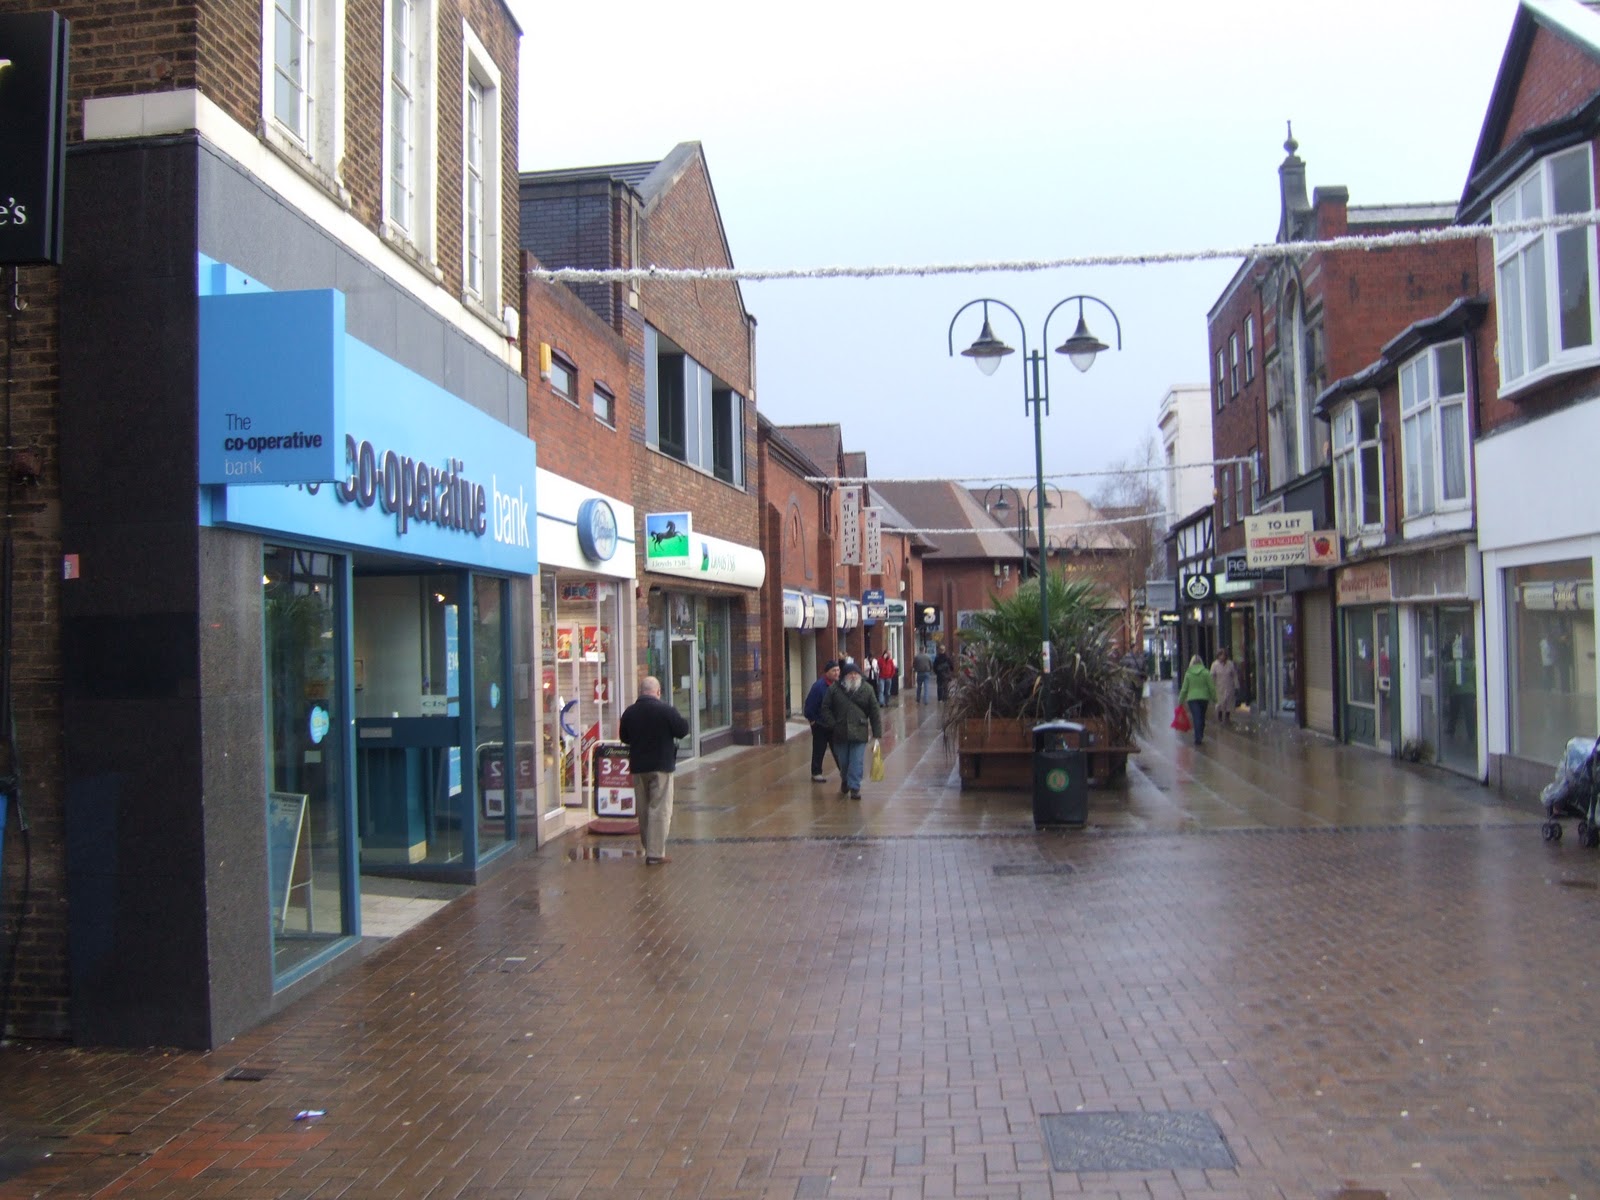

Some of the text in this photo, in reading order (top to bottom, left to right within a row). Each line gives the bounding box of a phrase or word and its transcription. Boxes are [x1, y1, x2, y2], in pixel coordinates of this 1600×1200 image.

[225, 413, 251, 430] The
[224, 431, 322, 453] co-operative
[225, 457, 263, 475] bank
[492, 472, 530, 549] bank
[1268, 520, 1282, 530] TO
[1285, 518, 1301, 528] LET
[652, 559, 687, 568] Lloyds TSB
[1253, 555, 1278, 563] 01270
[602, 758, 612, 775] 3
[620, 758, 630, 775] 2
